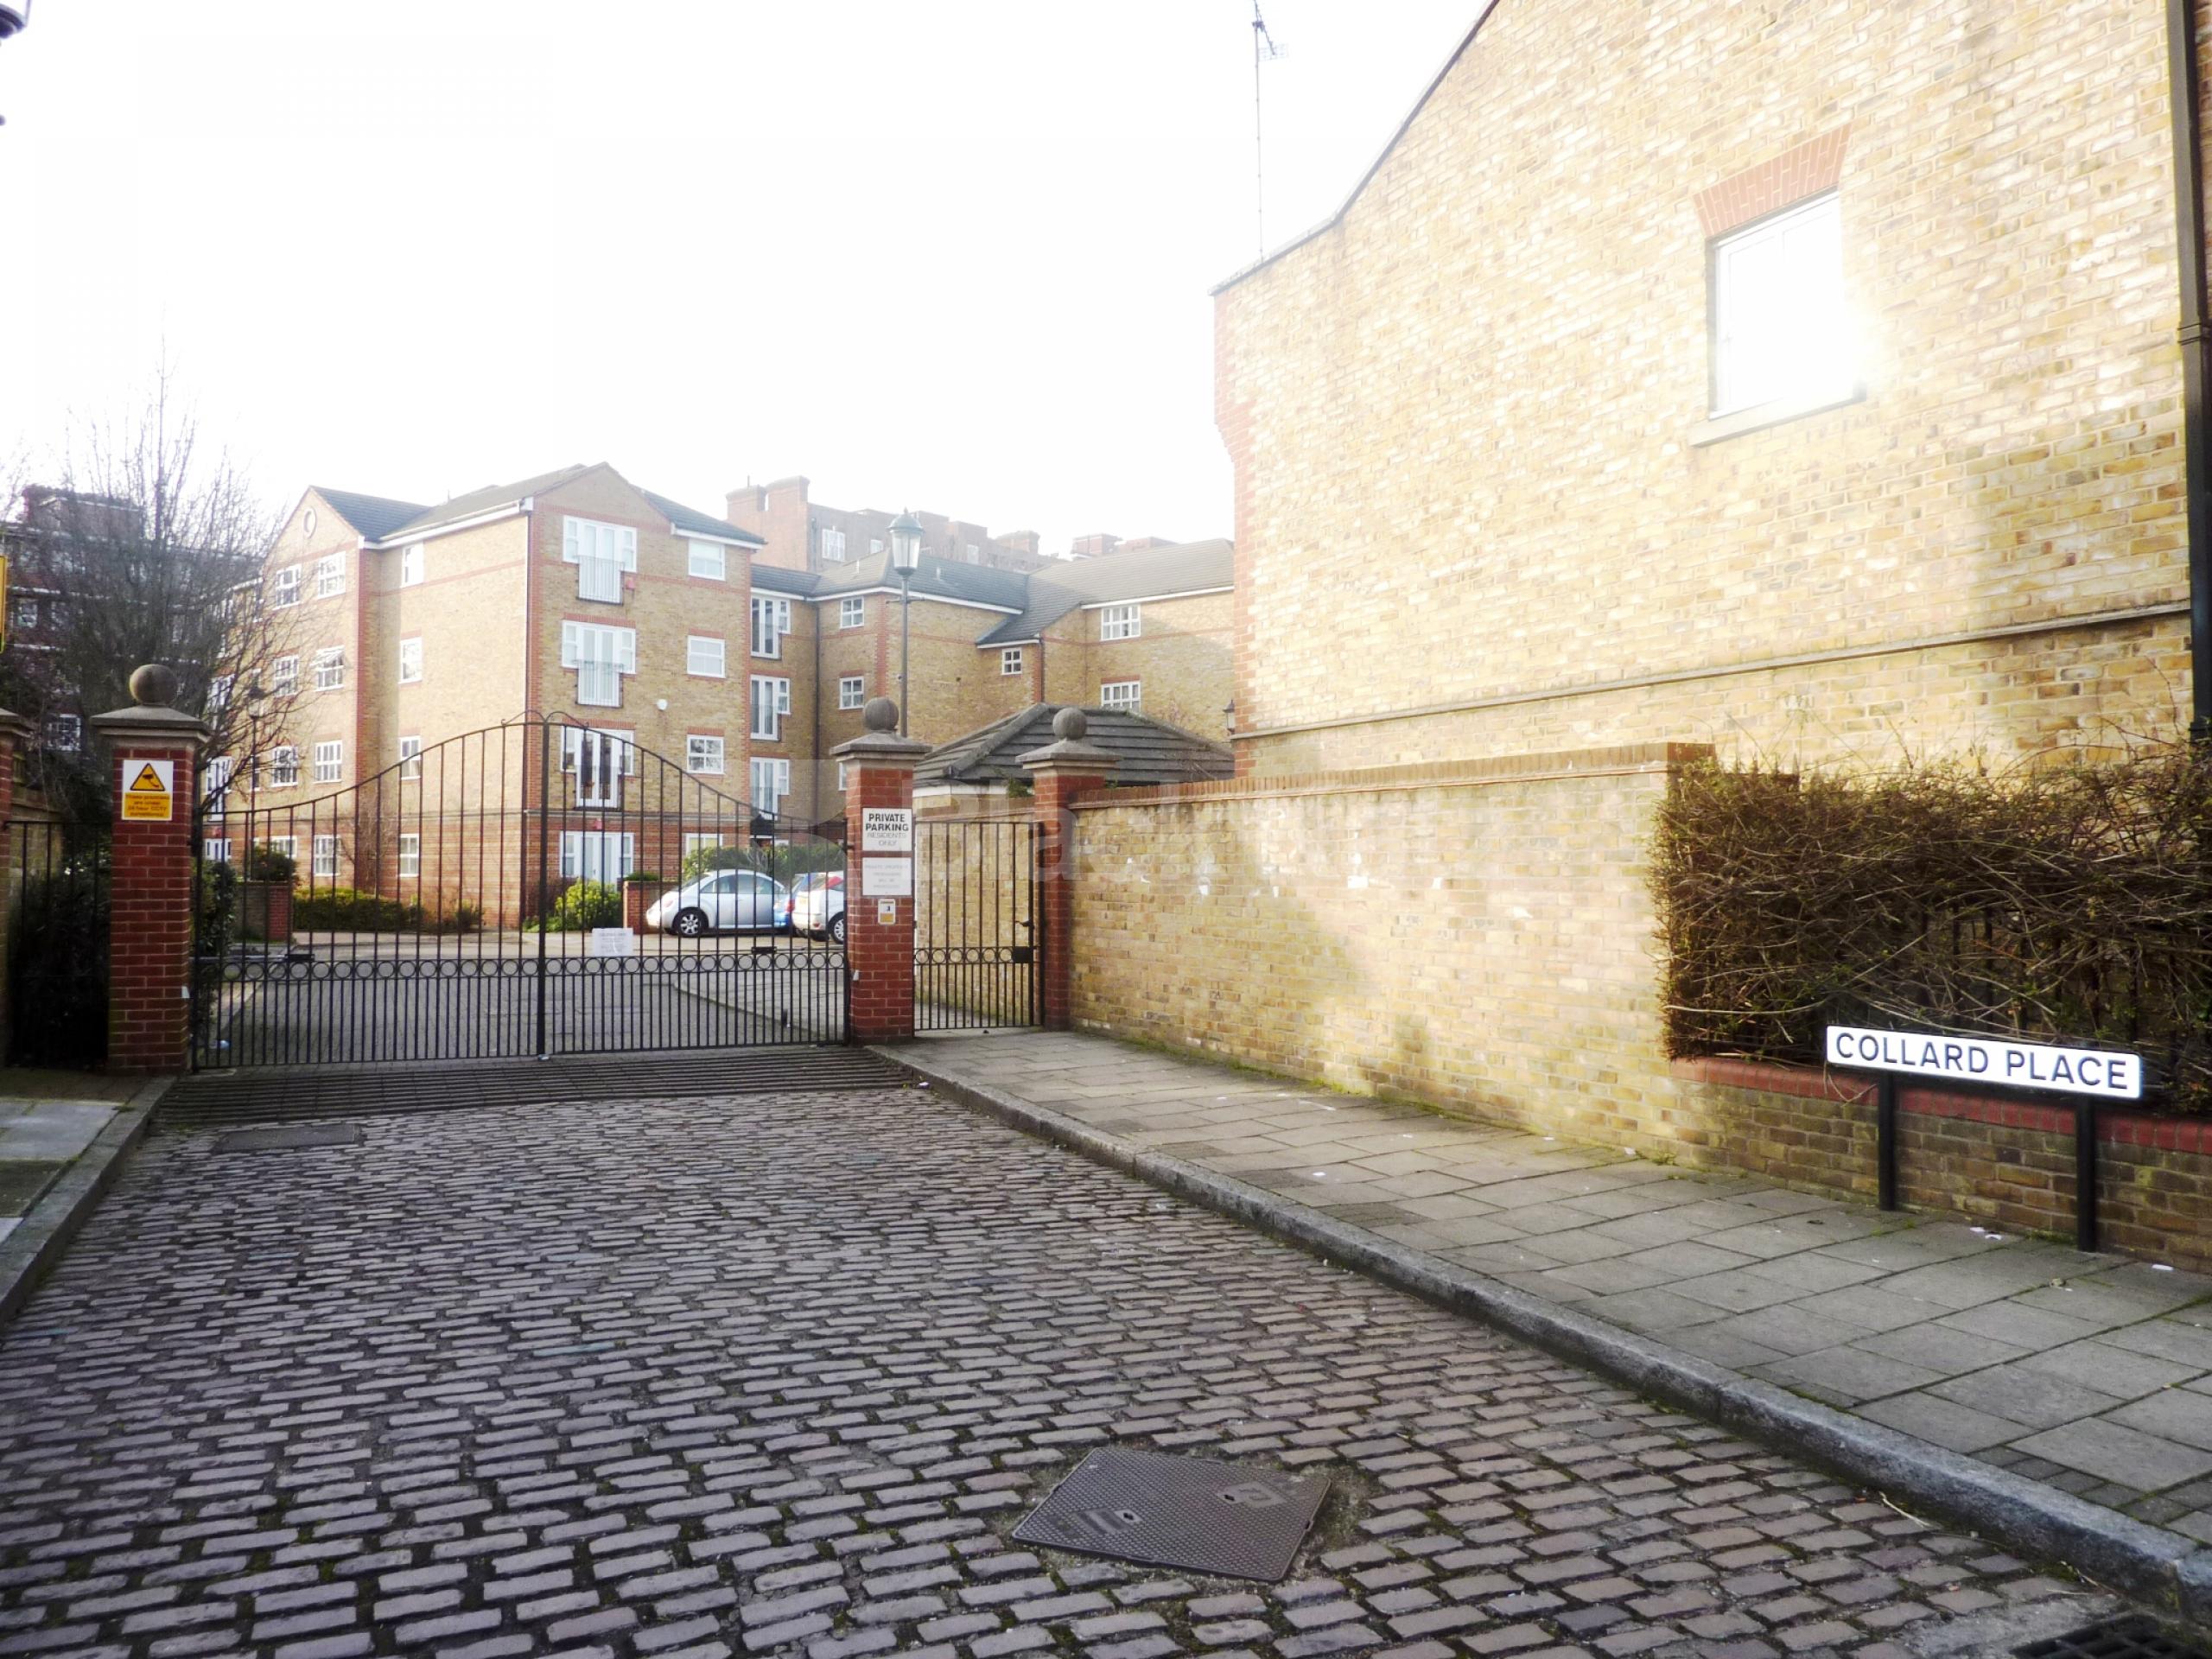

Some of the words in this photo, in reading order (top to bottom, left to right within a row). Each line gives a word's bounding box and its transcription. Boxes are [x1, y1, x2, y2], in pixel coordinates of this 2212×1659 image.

[868, 812, 906, 822] PRIVATE
[865, 822, 909, 831] PARKING
[1836, 1032, 1989, 1073] COLLARD
[2006, 1049, 2128, 1090] PLACE
